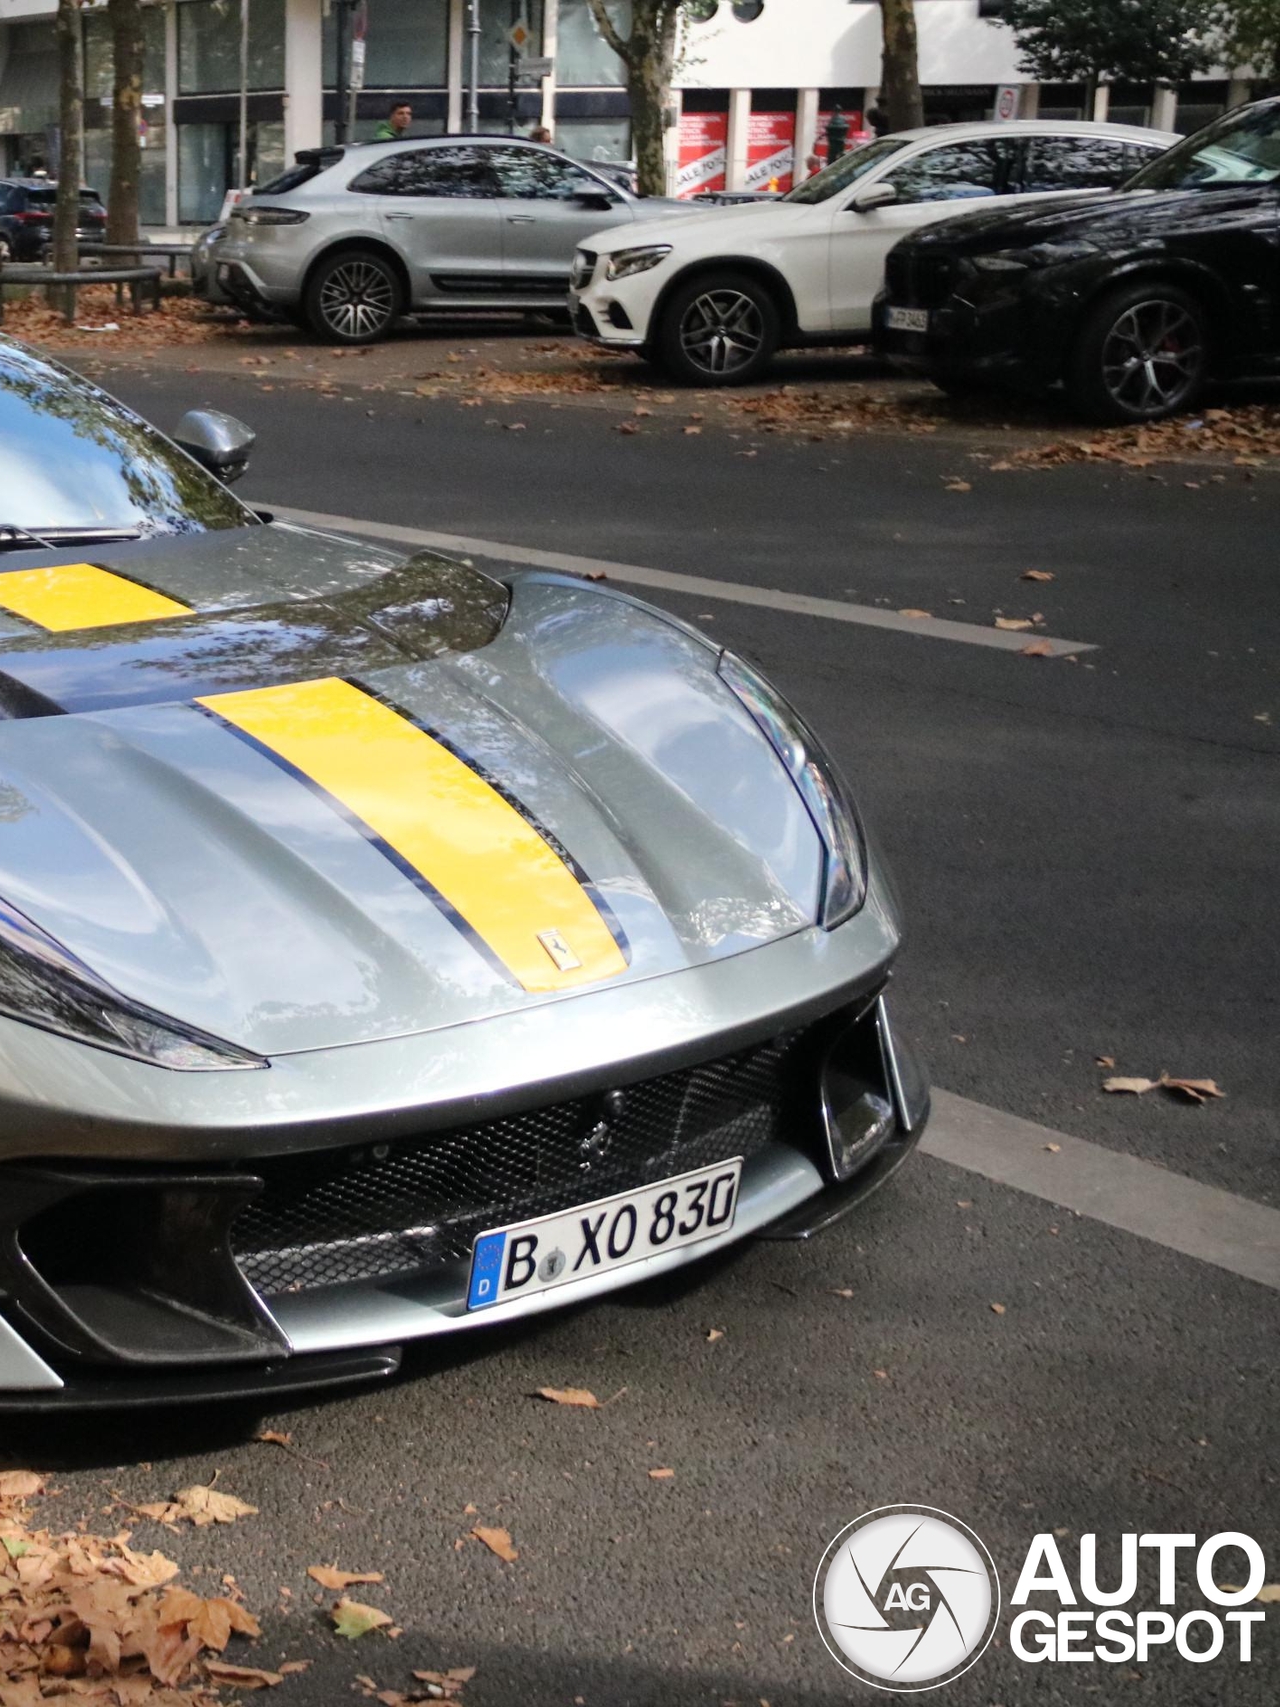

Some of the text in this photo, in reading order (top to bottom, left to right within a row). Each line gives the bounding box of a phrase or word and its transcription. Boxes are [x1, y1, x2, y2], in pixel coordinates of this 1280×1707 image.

[504, 1172, 735, 1291] B XO 830
[478, 1279, 490, 1297] D
